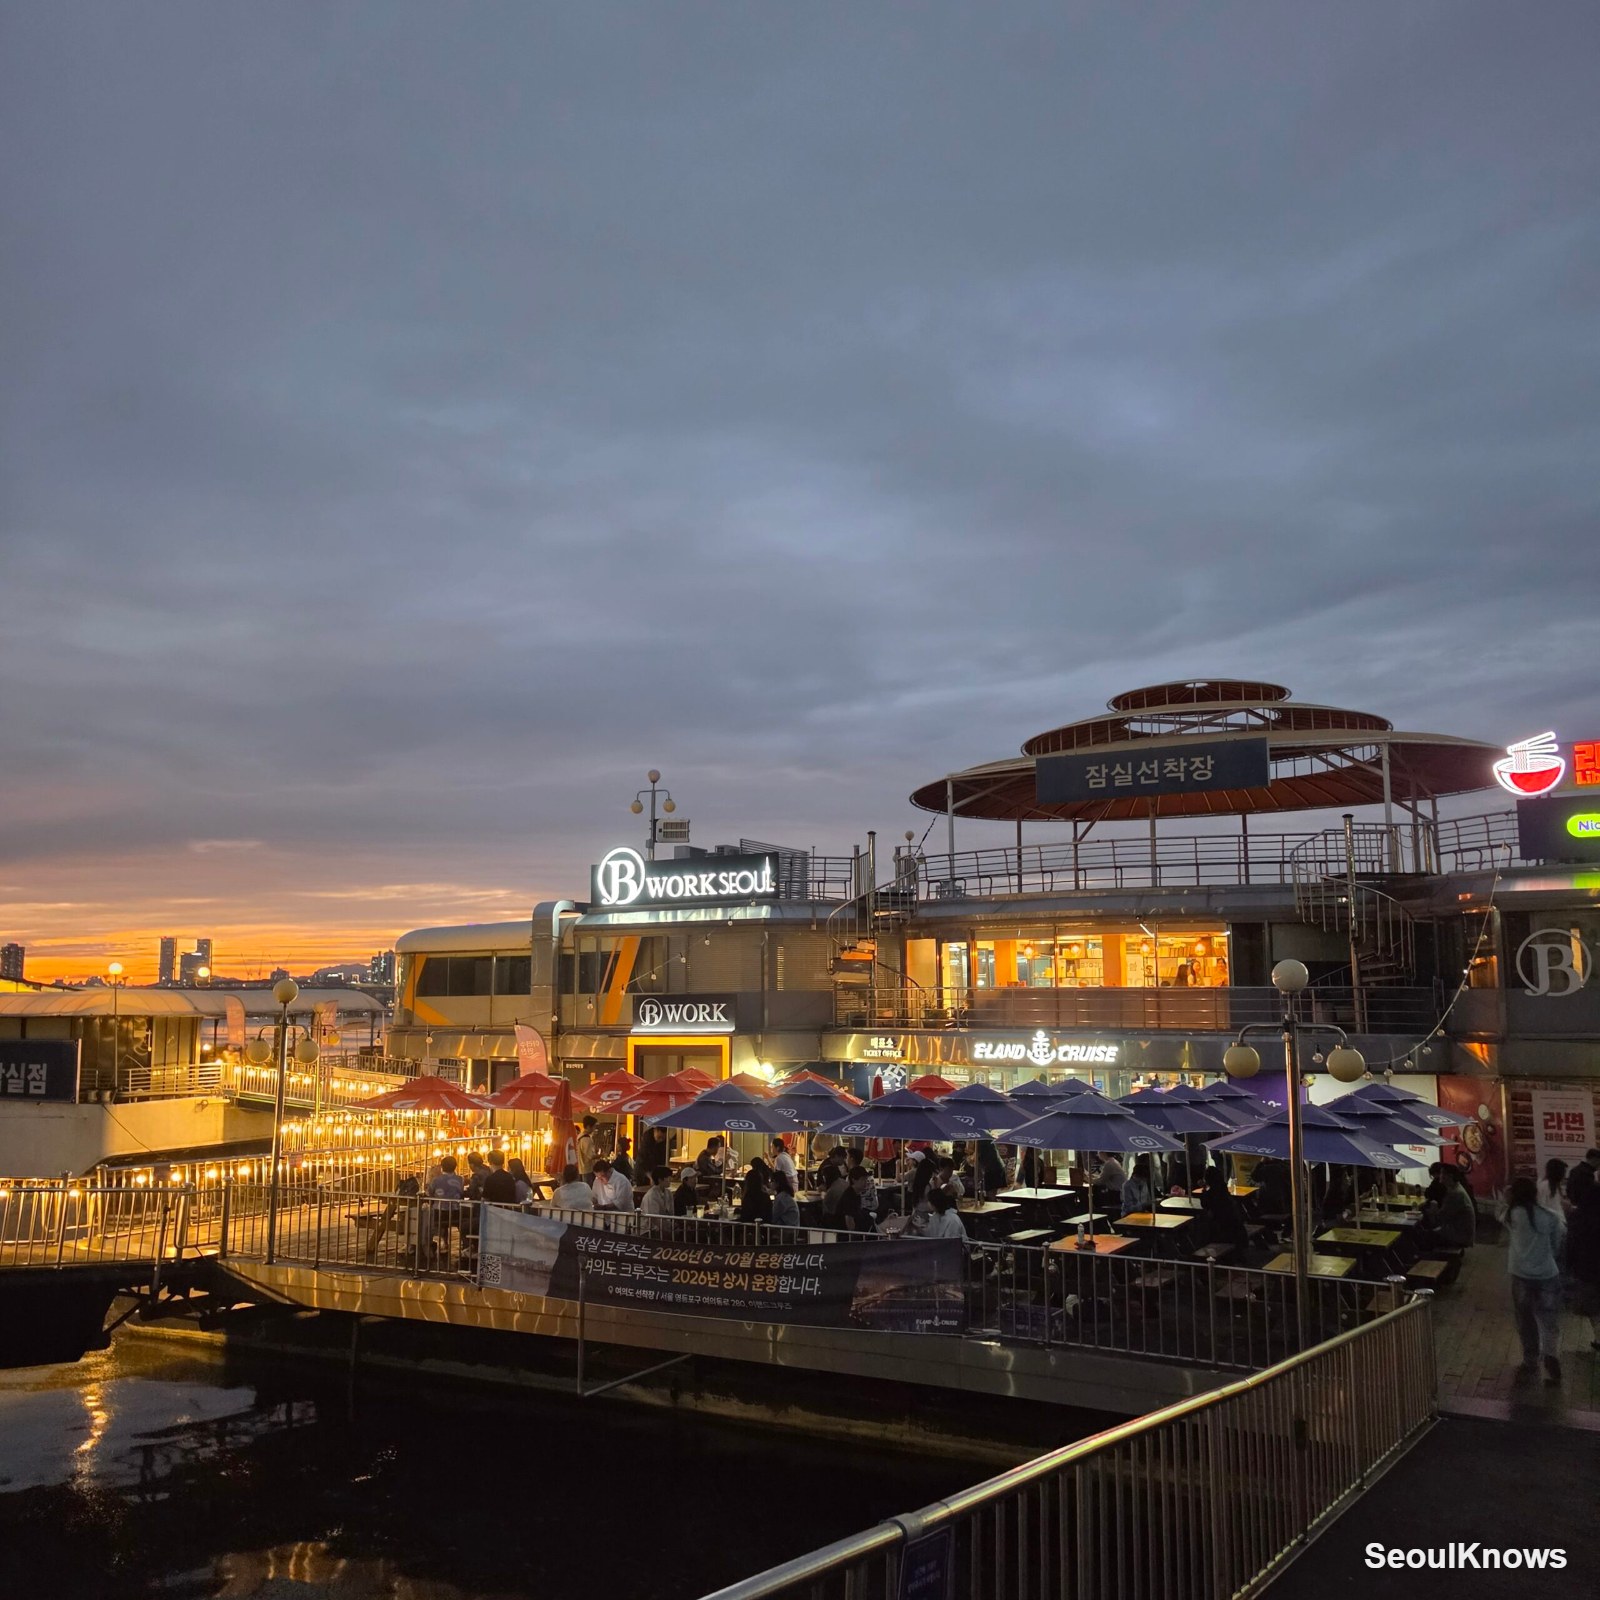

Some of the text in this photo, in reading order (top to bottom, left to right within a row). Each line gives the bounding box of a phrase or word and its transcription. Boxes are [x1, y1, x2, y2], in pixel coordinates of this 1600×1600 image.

[1085, 755, 1215, 788] 잠실선착장
[646, 873, 717, 898] WORK
[718, 856, 775, 895] SEOUL
[664, 1003, 728, 1023] WORK
[863, 1049, 902, 1058] TICKET OFFICE
[1058, 1045, 1119, 1062] CRUISE
[601, 1090, 623, 1101] G
[621, 1099, 649, 1112] G
[730, 1120, 750, 1128] CU
[847, 1124, 865, 1132] CU
[1543, 1112, 1585, 1131] 라면
[1135, 1138, 1154, 1146] CU
[1565, 1134, 1585, 1143] 공간
[575, 1236, 828, 1270] 잠실 크루즈는 2026년 8~10월 운항합니다.
[619, 1262, 670, 1283] 크루즈는
[671, 1268, 720, 1288] 2026년
[722, 1272, 749, 1291] 상시
[751, 1273, 822, 1296] 운항합니다.
[614, 1286, 635, 1297] 여의도
[635, 1288, 655, 1299] 선착장
[660, 1292, 674, 1302] 서울
